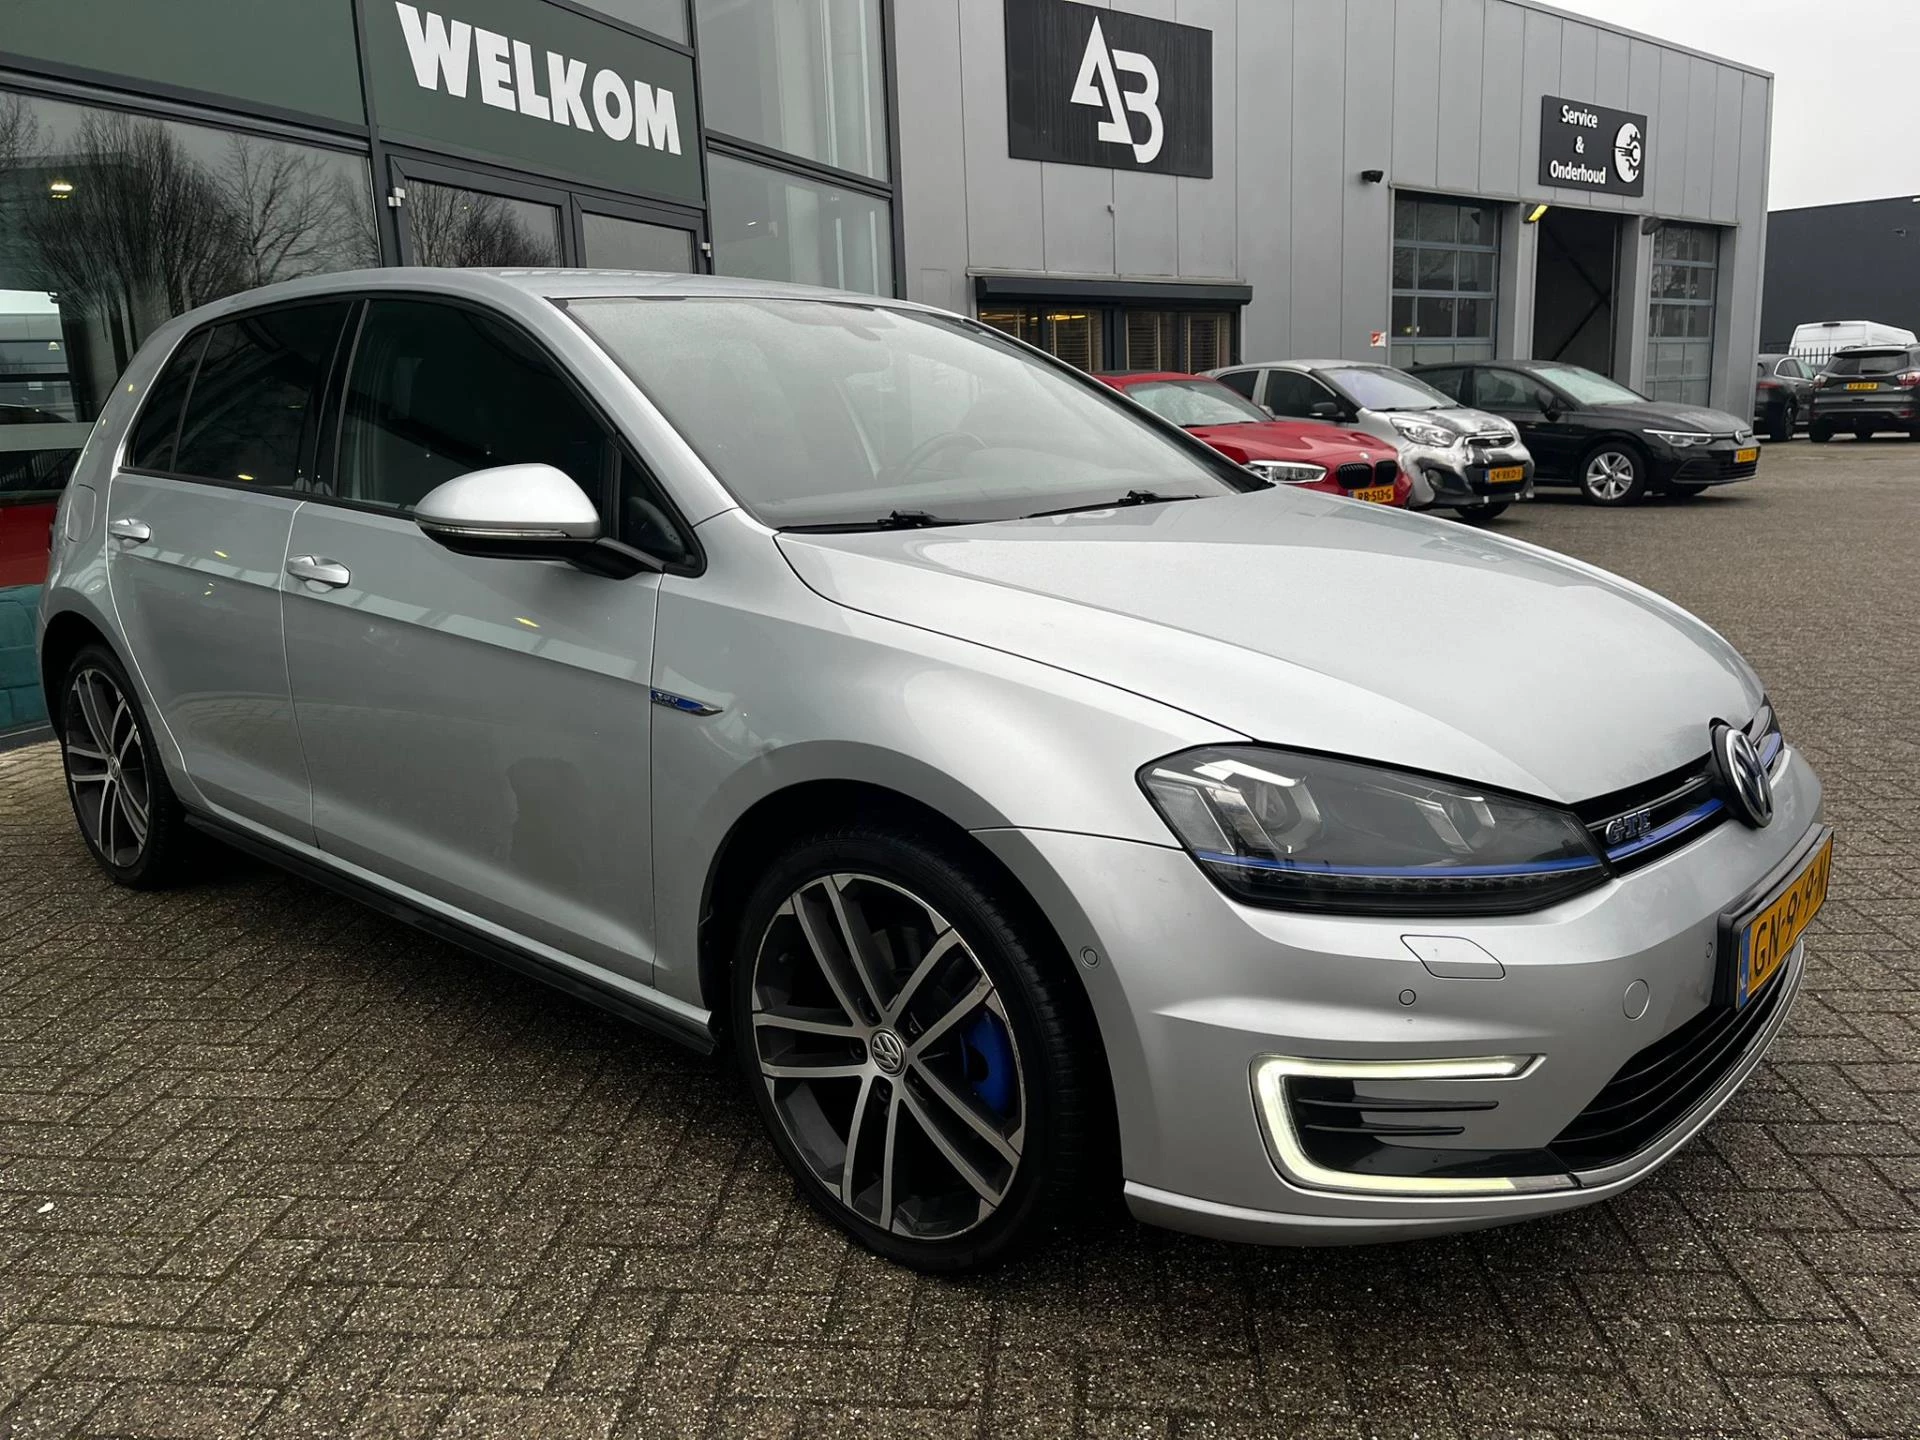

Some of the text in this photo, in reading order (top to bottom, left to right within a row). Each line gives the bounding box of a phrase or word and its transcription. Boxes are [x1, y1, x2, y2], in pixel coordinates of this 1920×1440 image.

[395, 1, 682, 155] WELKOM
[1070, 15, 1164, 163] AB
[1561, 105, 1598, 128] Service
[1575, 136, 1585, 153] &
[1550, 160, 1606, 184] Onderhoud
[1605, 808, 1651, 844] GTE
